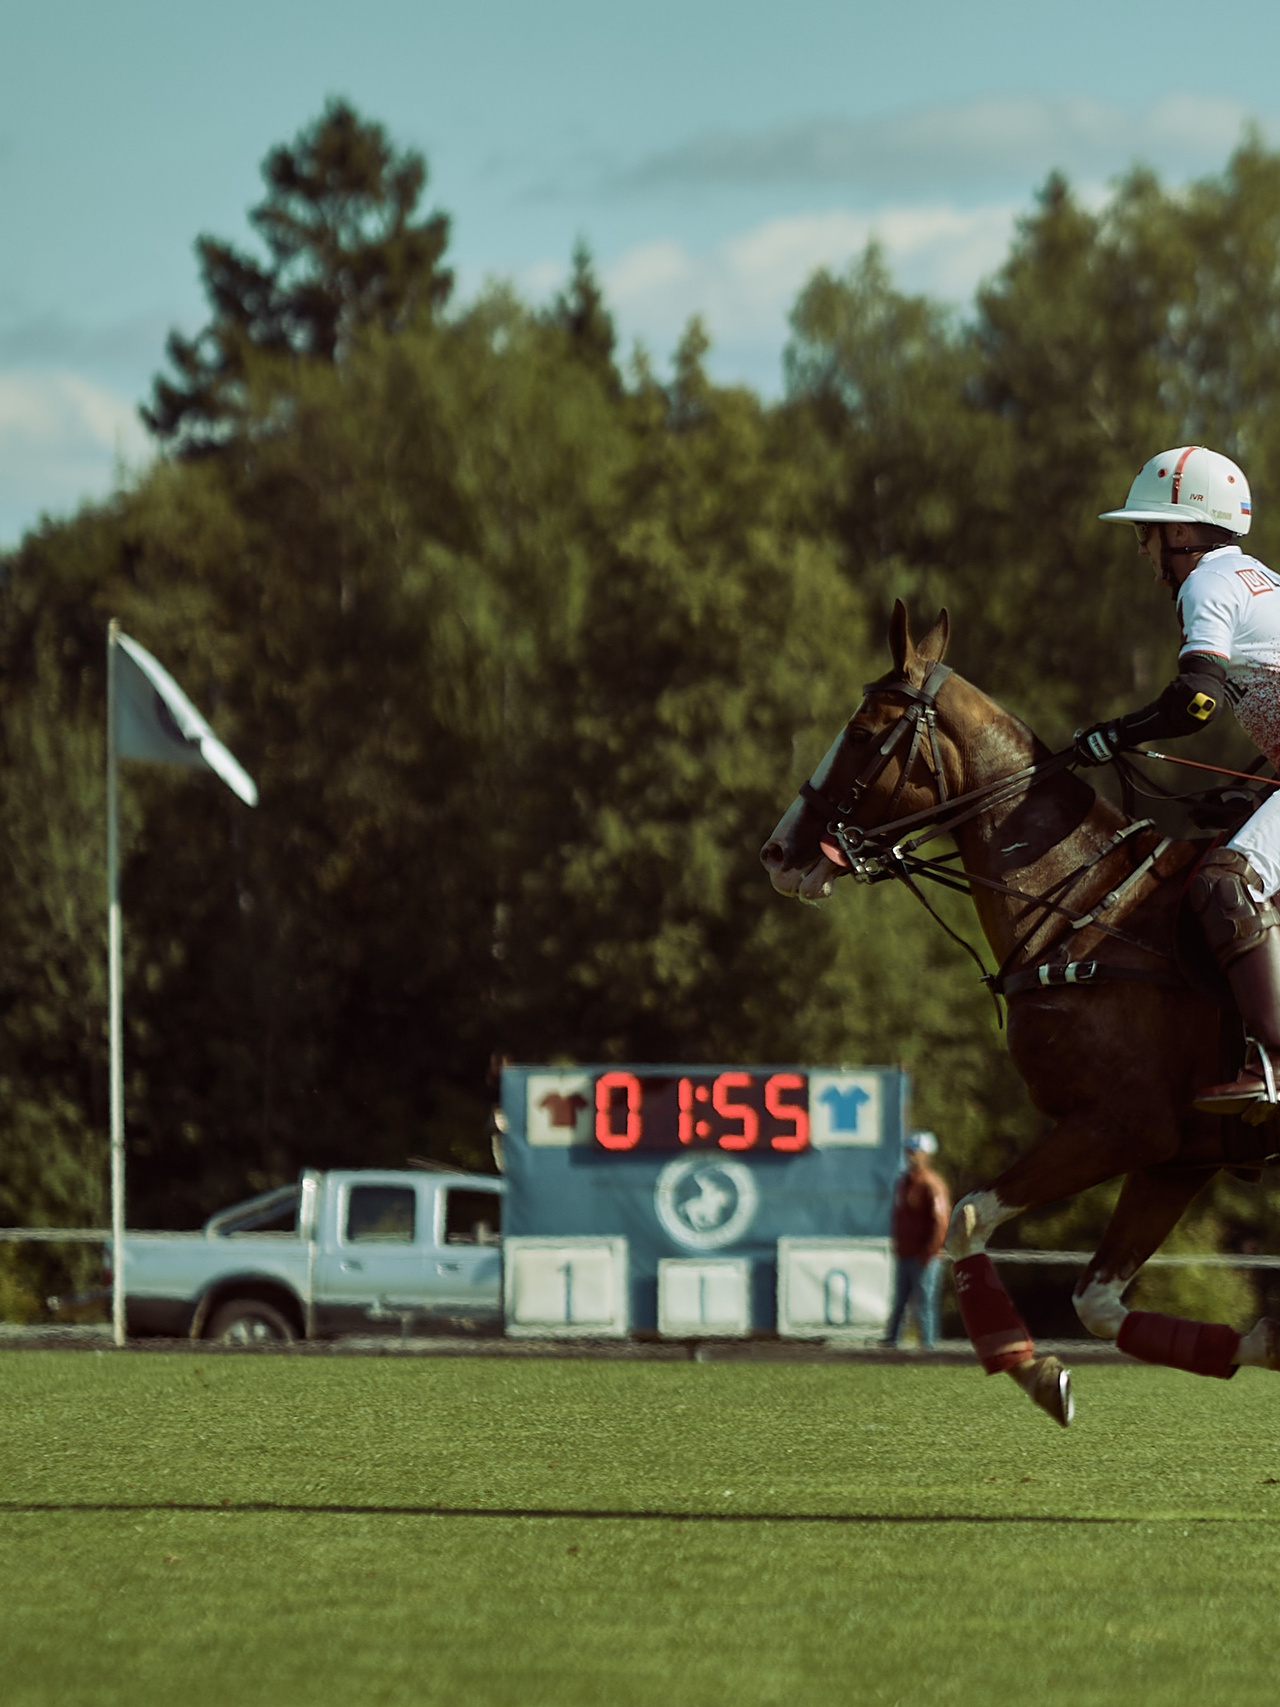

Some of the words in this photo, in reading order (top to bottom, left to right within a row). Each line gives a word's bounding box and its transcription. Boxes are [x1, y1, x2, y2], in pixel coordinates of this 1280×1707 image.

[595, 1071, 809, 1152] 01:55
[557, 1261, 574, 1325] 1
[825, 1270, 850, 1325] 0
